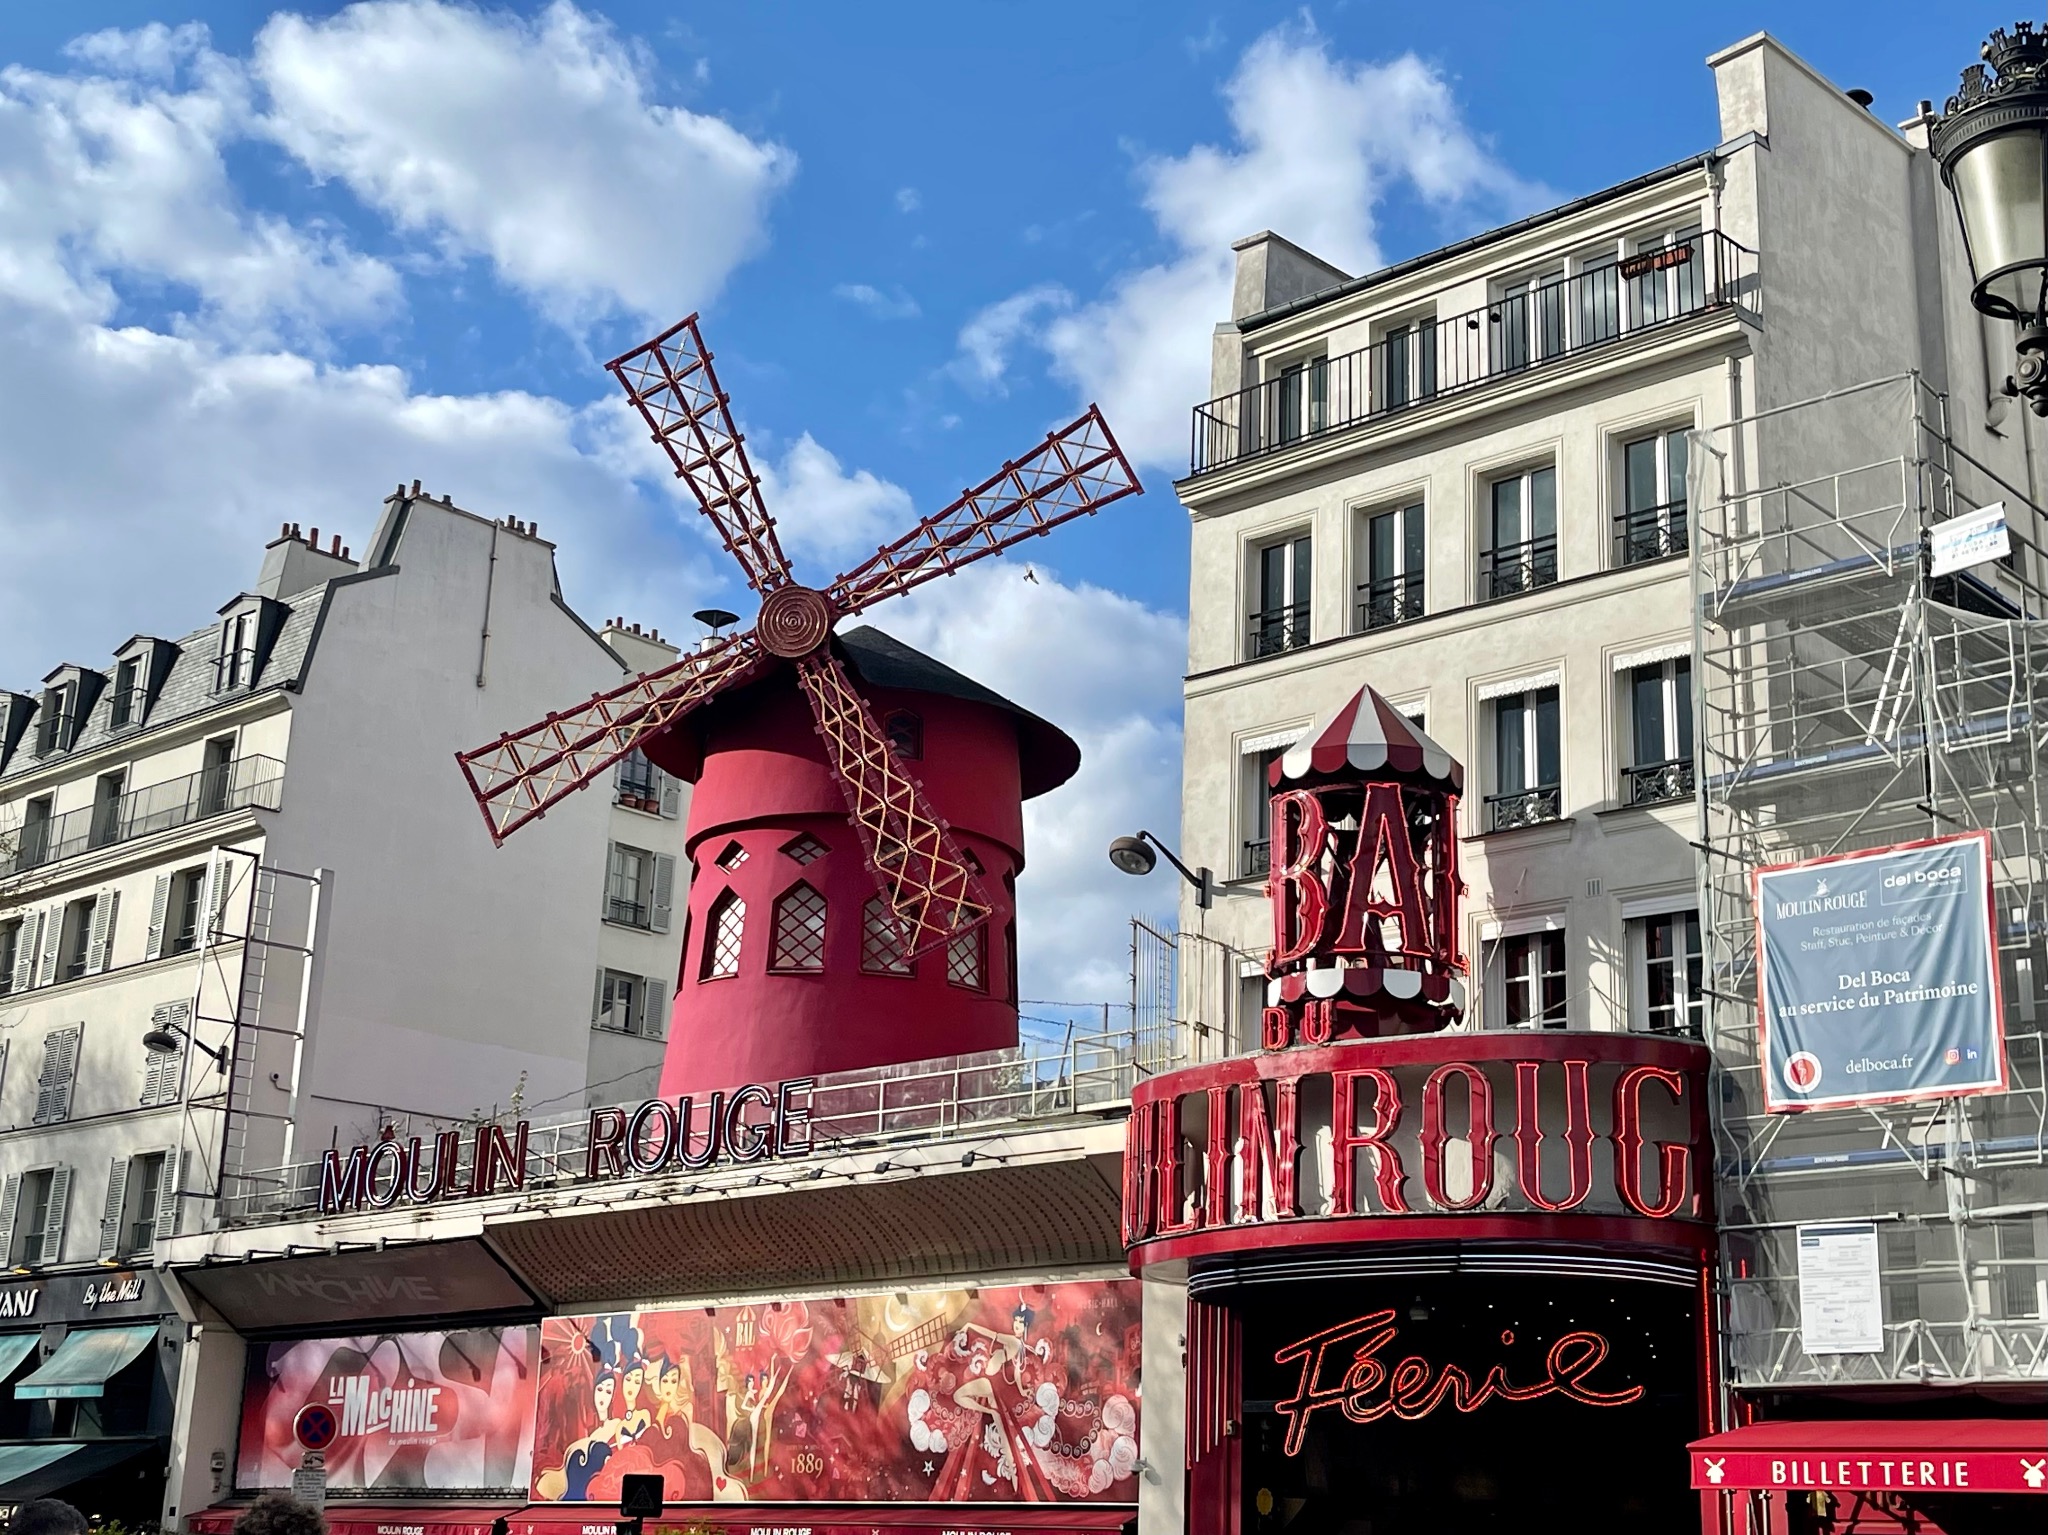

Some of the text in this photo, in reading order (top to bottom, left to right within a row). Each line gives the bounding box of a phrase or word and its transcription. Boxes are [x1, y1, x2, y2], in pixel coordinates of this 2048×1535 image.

[1883, 866, 1962, 888] del boca
[1776, 890, 1868, 921] MOULIN ROUGE
[1800, 923, 1943, 951] Staff, Stuc, Peinture & Décor
[1812, 912, 1932, 937] Restauration de façades
[1838, 969, 1911, 990] Del Boca
[1779, 980, 1979, 1018] au service du Patrimoine
[1262, 999, 1334, 1050] DU
[1845, 1053, 1914, 1074] delboca.fr
[317, 1076, 817, 1216] MOULIN ROUGE
[82, 1278, 143, 1310] By the Mill
[735, 1322, 756, 1347] BAL
[329, 1376, 344, 1398] LA
[1275, 1309, 1646, 1457] Féerie
[791, 1453, 824, 1479] 1889
[1771, 1460, 1969, 1486] BILLETTERIE
[582, 1525, 610, 1535] MOULIN
